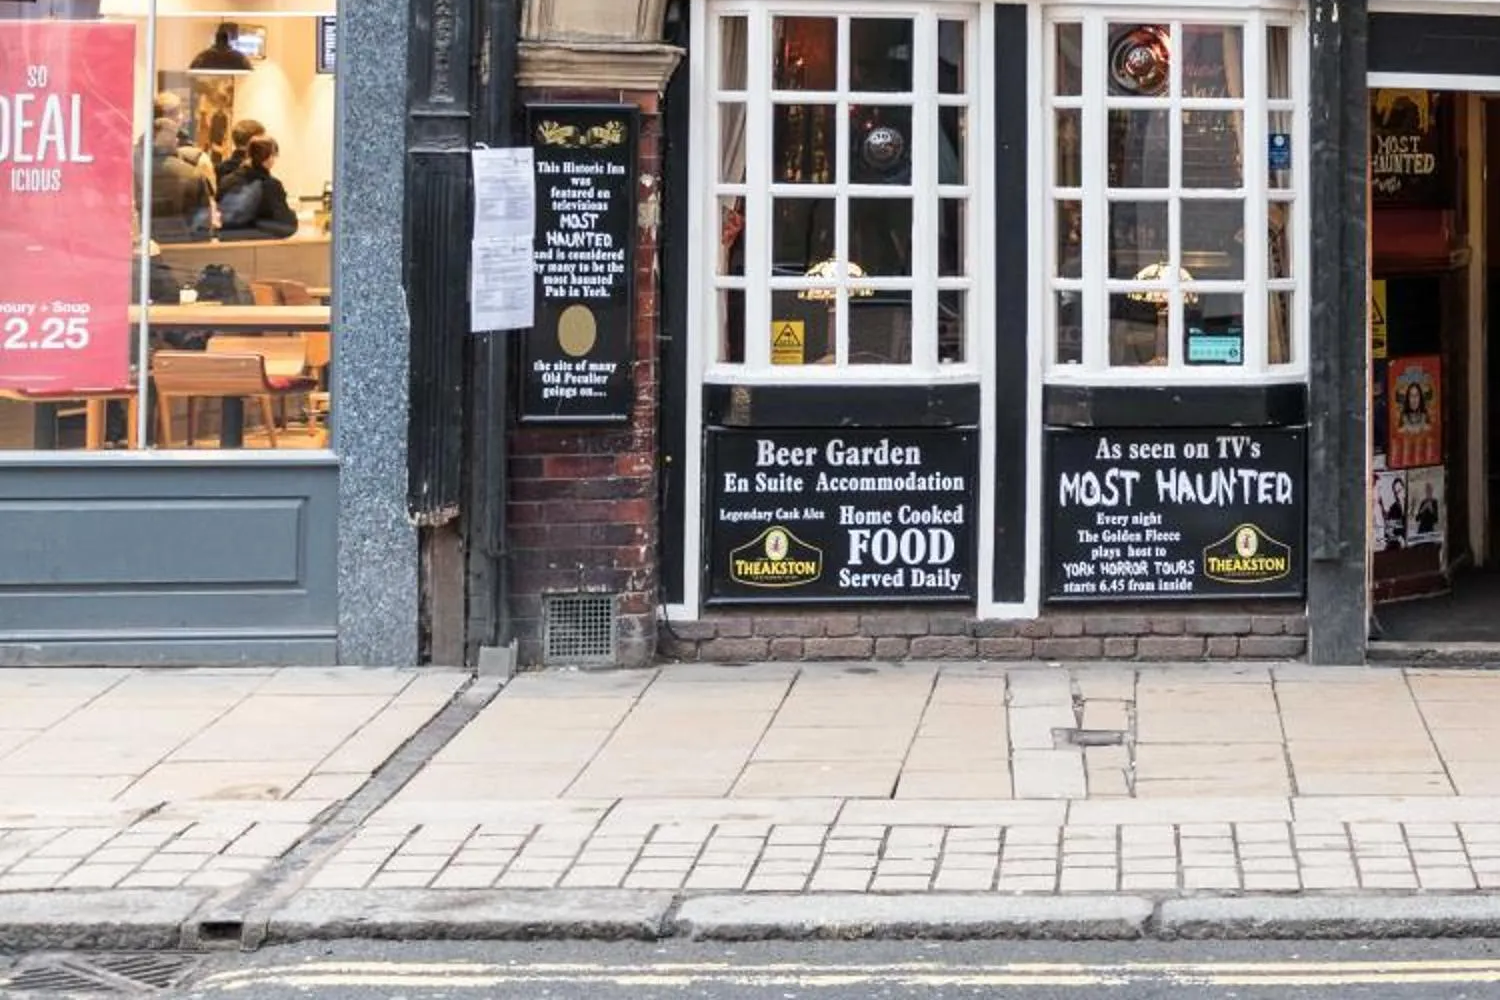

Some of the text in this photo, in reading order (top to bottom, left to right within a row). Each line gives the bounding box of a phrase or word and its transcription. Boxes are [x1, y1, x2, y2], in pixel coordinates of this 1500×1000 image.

[27, 65, 48, 88] SO
[1376, 135, 1421, 153] MOST
[537, 161, 625, 175] This Historic Inn
[11, 168, 62, 192] ICIOUS
[570, 177, 592, 187] was
[551, 185, 611, 199] featured on
[559, 212, 599, 229] MOST
[545, 231, 613, 248] HAUNTED
[534, 249, 625, 261] and is considered
[547, 264, 576, 275] many
[579, 263, 589, 273] to
[592, 262, 605, 273] be
[607, 262, 625, 273] the
[543, 274, 613, 285] most haunted
[545, 285, 566, 297] Pub
[569, 286, 580, 297] in
[533, 360, 617, 374] the site of many
[541, 372, 609, 384] Old Peculier
[542, 386, 577, 399] goings
[756, 438, 921, 466] Beer Garden
[1095, 436, 1262, 460] As seen on TV's
[724, 472, 965, 493] En Suite Accommodation
[1059, 467, 1293, 507] MOST HAUNTED
[719, 507, 825, 523] Legendary Cask Ales
[839, 504, 965, 525] Home Cooked
[1096, 512, 1162, 527] Every night
[1077, 529, 1181, 542] The Golden Fleece
[847, 528, 955, 566] FOOD
[1091, 544, 1167, 561] plays host to
[735, 559, 816, 575] THEAKSTON
[1062, 559, 1195, 578] YORK HORROR TOURS
[1208, 557, 1286, 573] THEAKSTON
[839, 568, 961, 591] Served Daily
[1063, 578, 1193, 593] starts 6.45 from inside
